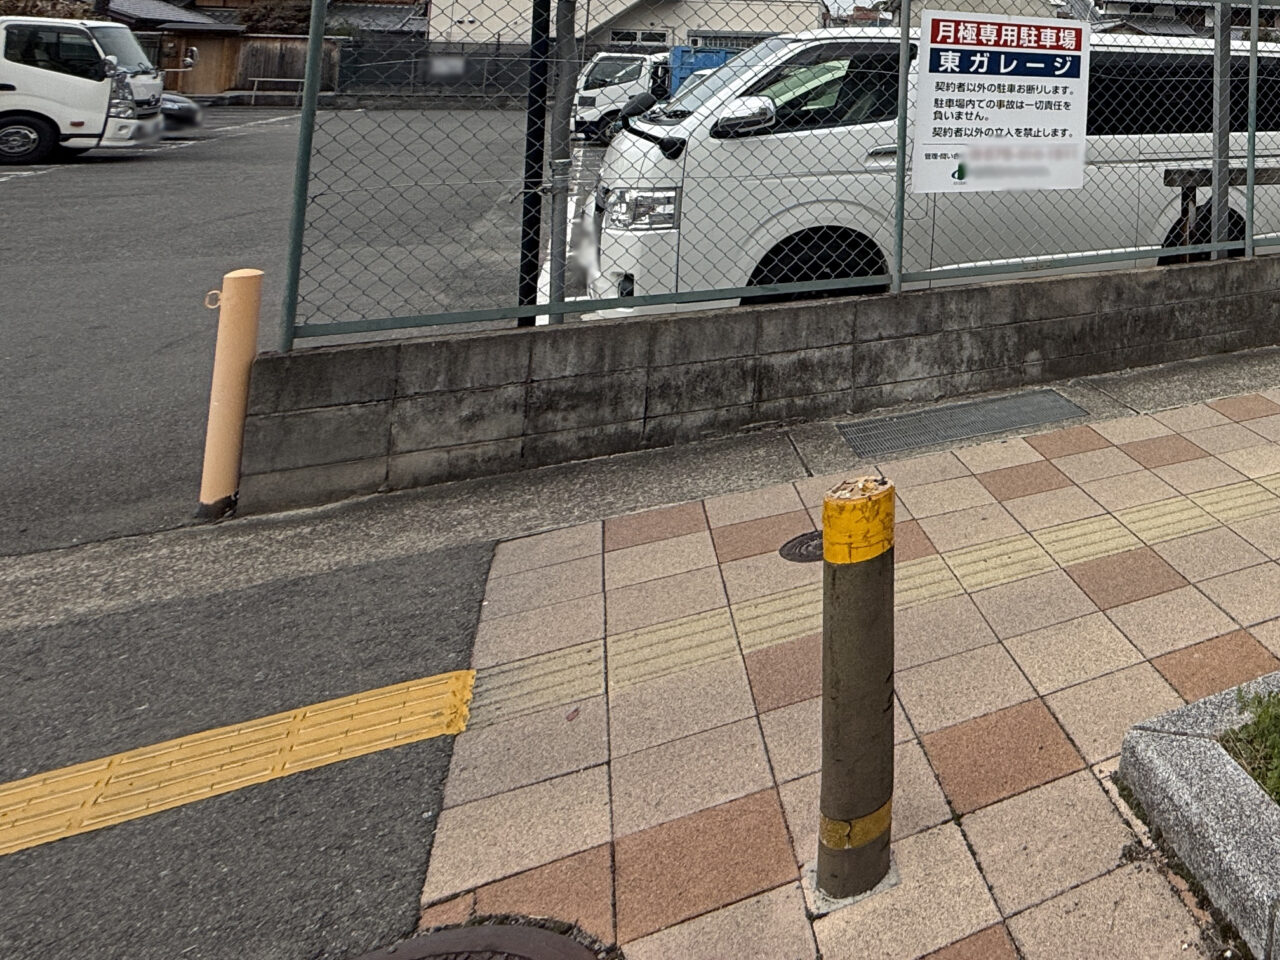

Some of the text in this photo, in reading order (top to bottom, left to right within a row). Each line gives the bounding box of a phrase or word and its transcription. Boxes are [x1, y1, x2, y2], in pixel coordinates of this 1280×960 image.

[936, 22, 1077, 50] 月極専用駐車場
[938, 51, 1072, 75] 東ガレージ
[935, 81, 1074, 96] 契約者以外の駐車お断りします。
[932, 110, 990, 122] 負いません。
[932, 126, 1073, 138] 契約者以外の立入を禁止します。
